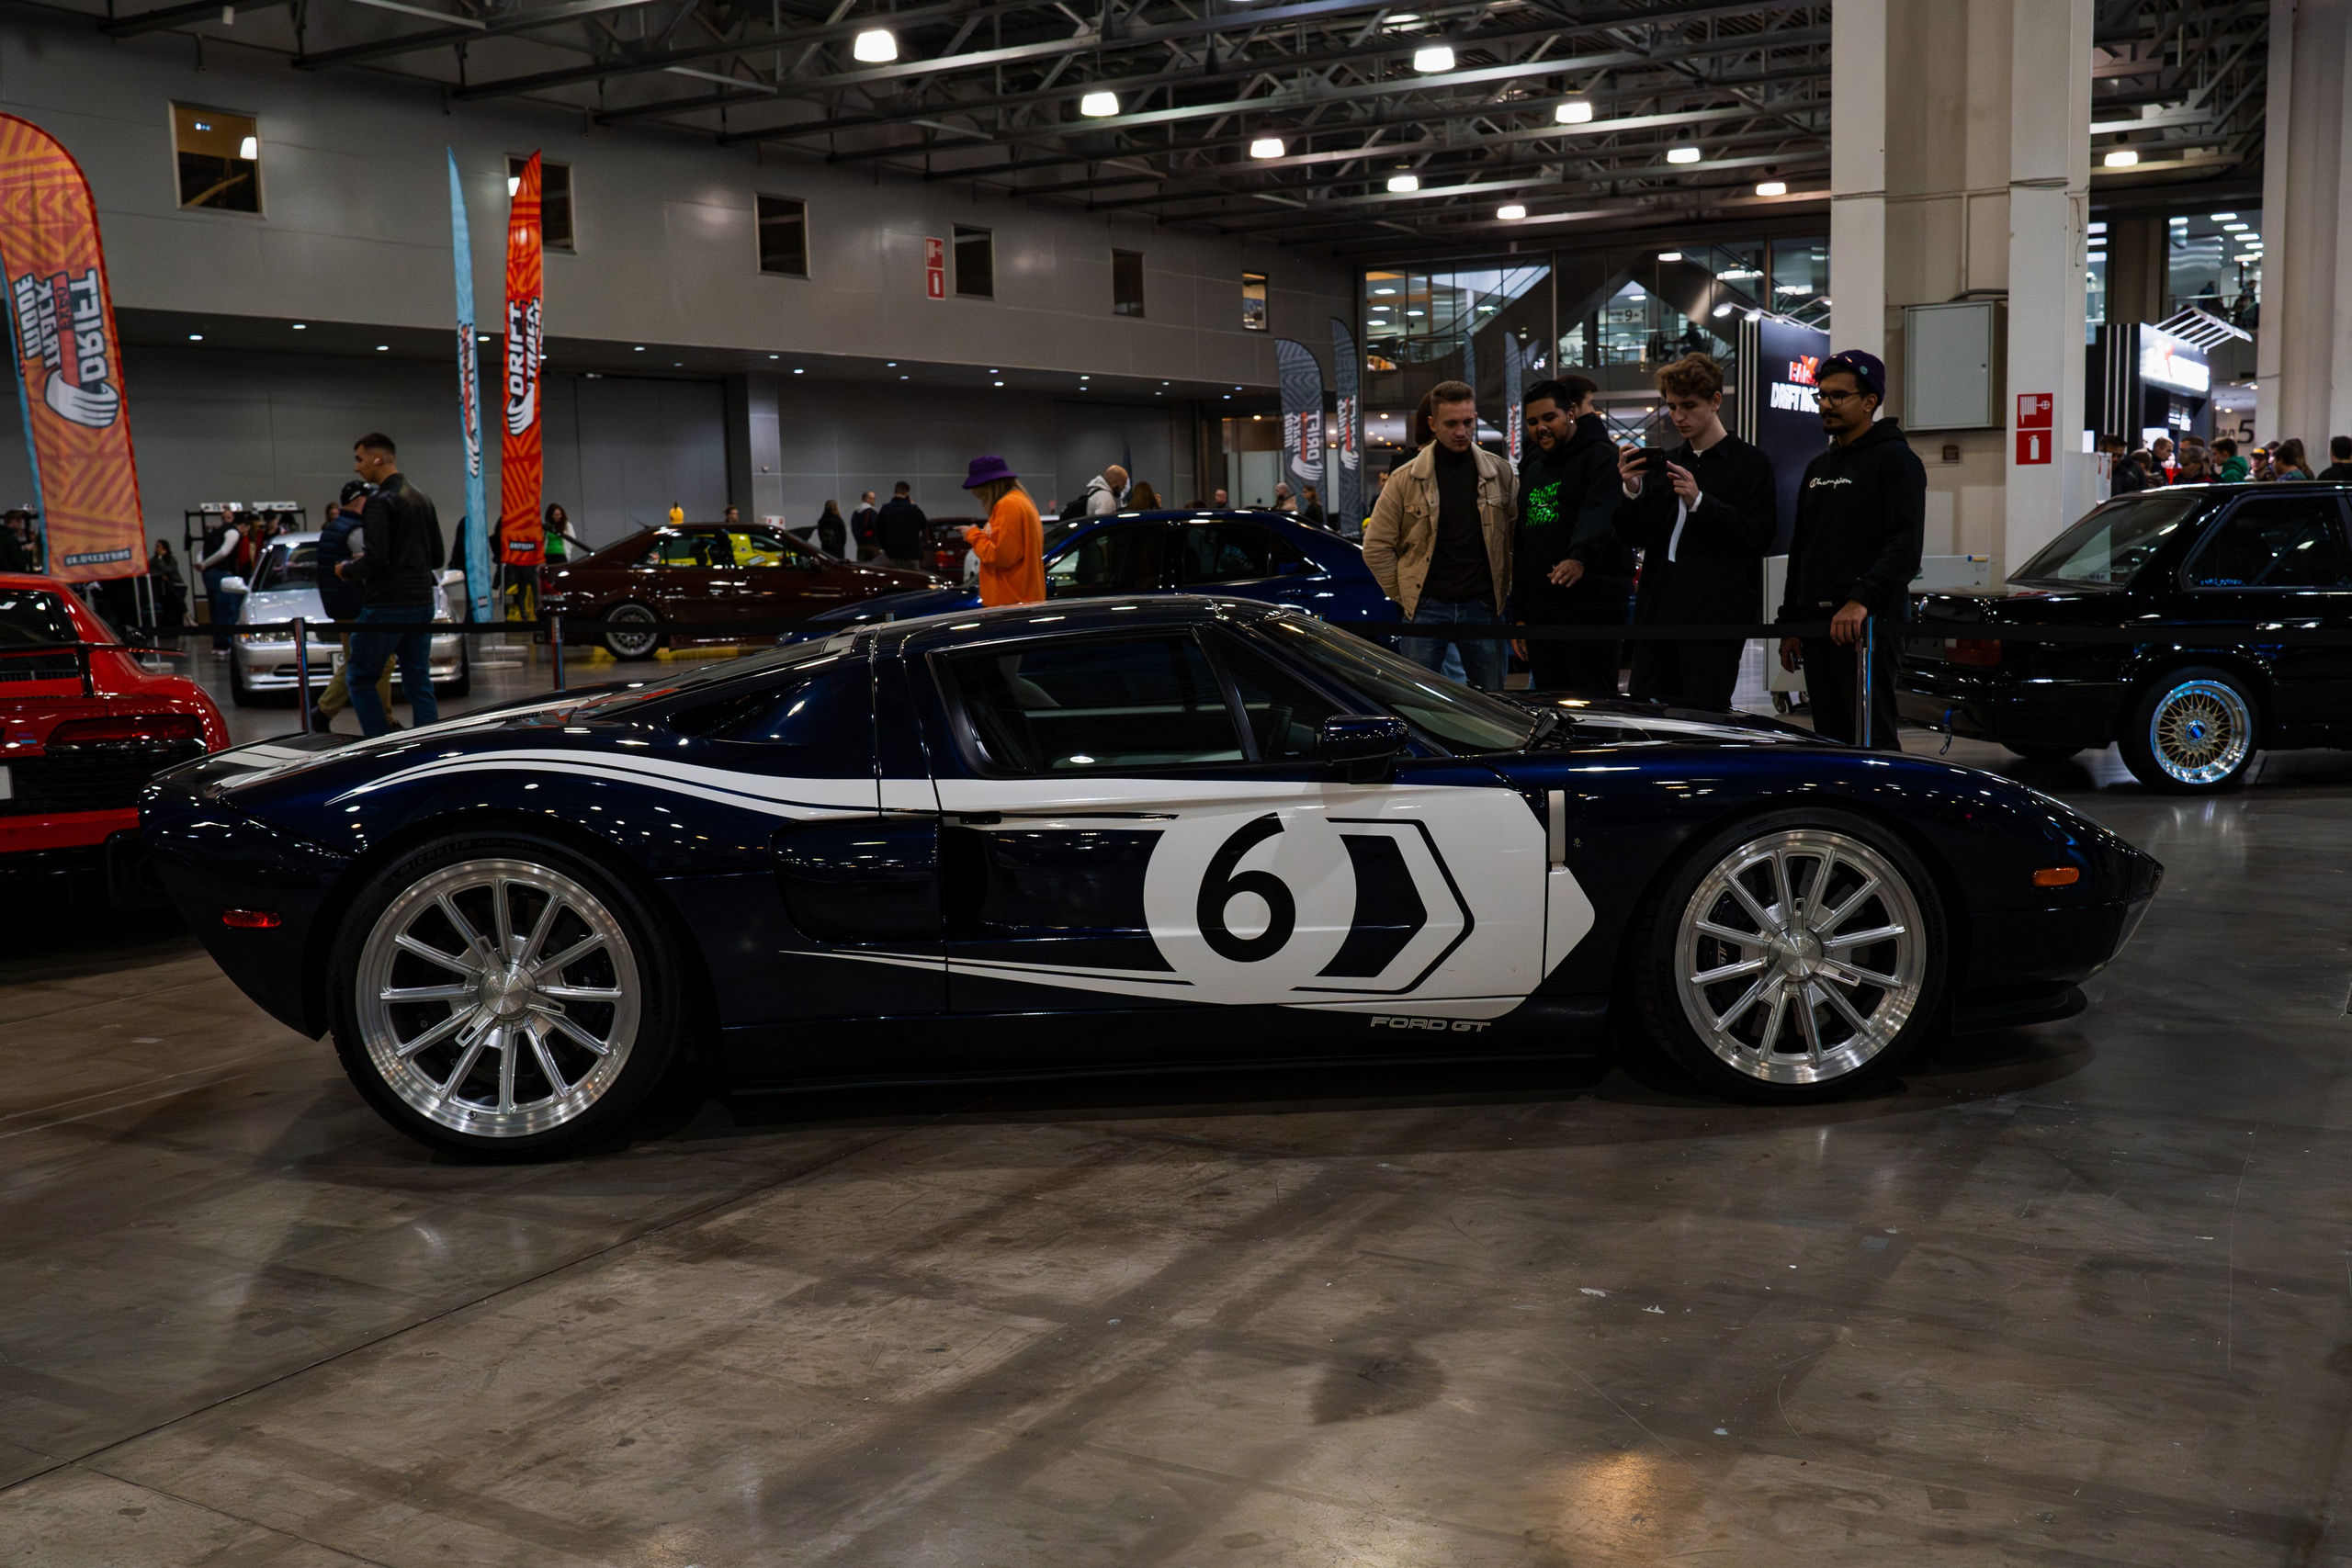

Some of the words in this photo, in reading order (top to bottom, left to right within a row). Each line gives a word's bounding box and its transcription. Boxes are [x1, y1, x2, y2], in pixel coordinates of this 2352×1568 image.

[508, 301, 525, 397] DRIFT
[2237, 419, 2255, 444] 5
[1809, 477, 1853, 490] Champion
[398, 839, 471, 875] MICHELIN
[1196, 812, 1296, 963] 6
[1370, 1016, 1448, 1031] FORD
[1451, 1020, 1492, 1032] GT
